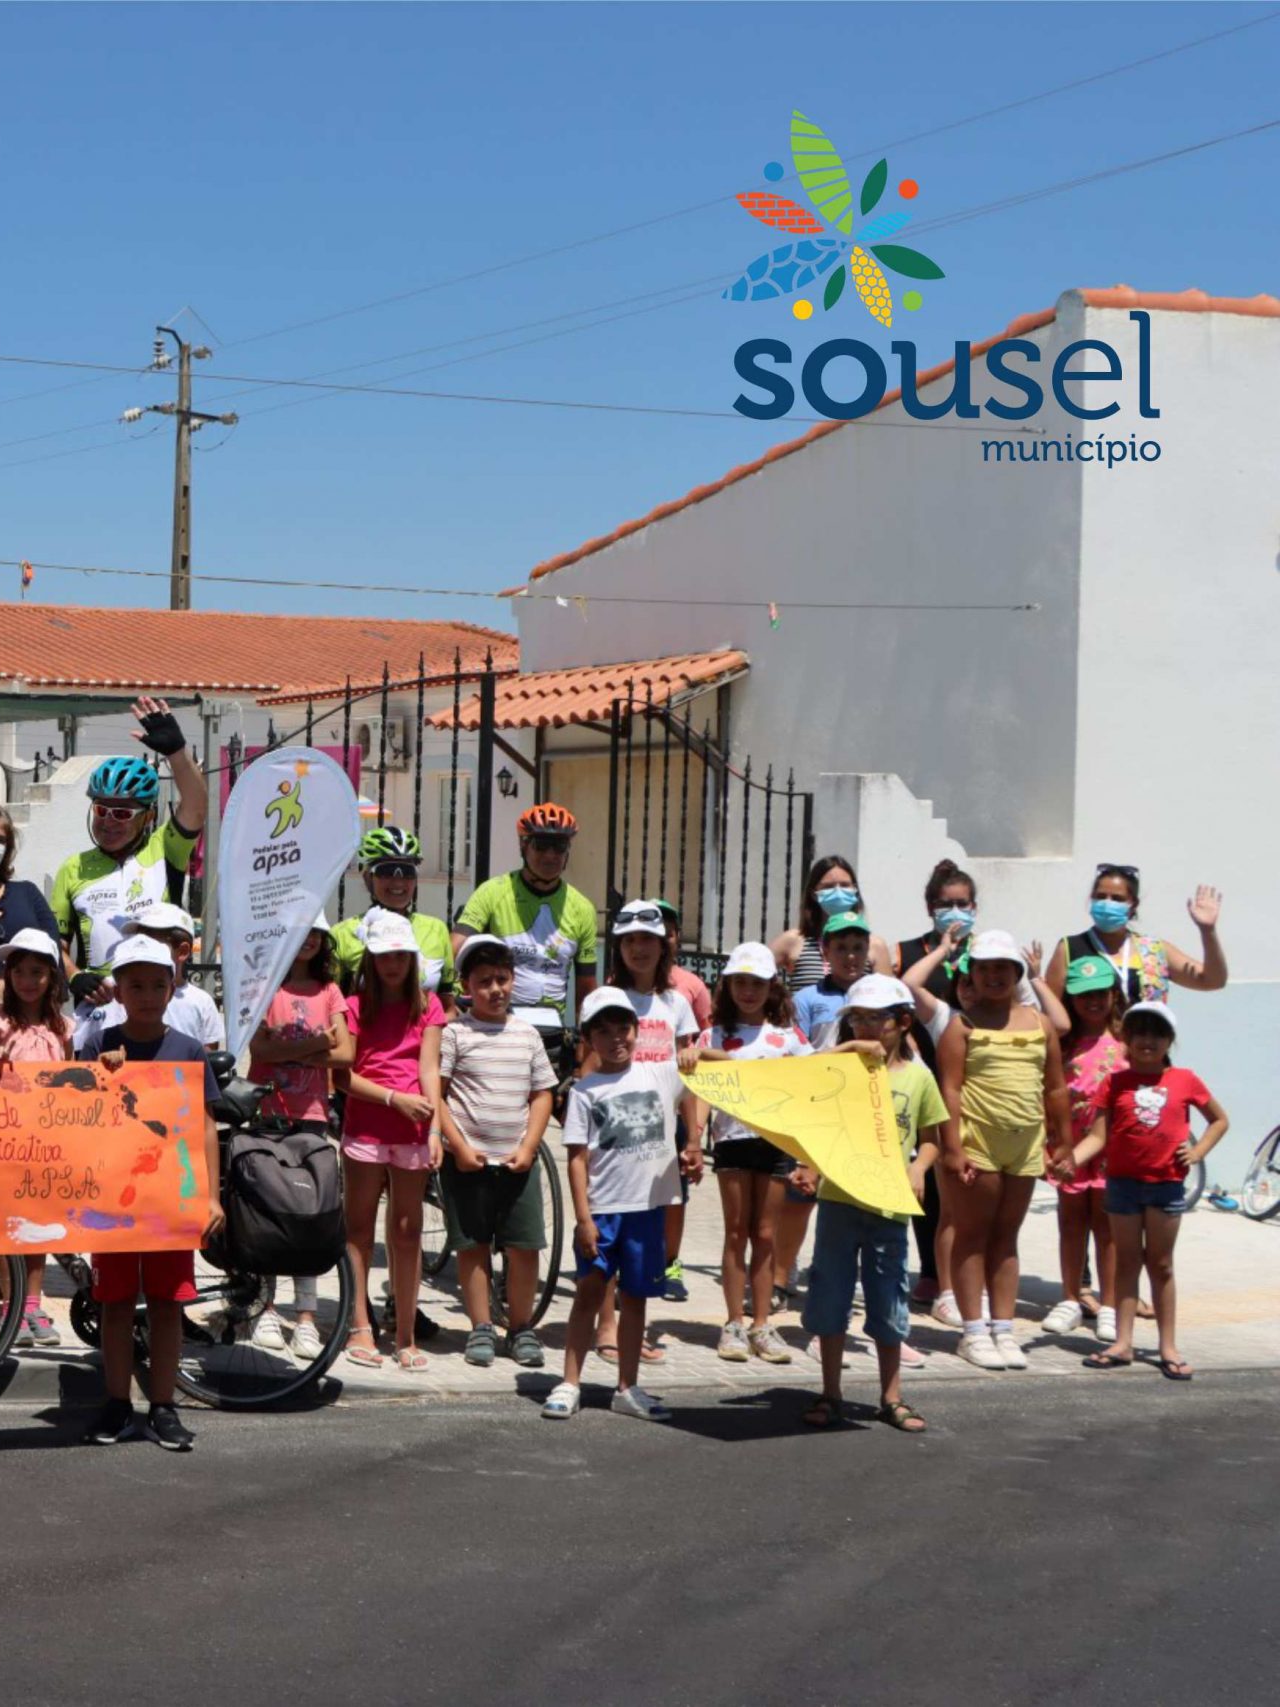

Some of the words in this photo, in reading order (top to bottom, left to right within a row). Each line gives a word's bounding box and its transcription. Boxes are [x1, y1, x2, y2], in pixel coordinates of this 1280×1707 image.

[253, 848, 301, 875] apsa
[86, 892, 118, 902] apsa
[125, 898, 153, 913] apsa
[637, 1018, 667, 1030] EAM
[38, 1092, 107, 1129] Sousel
